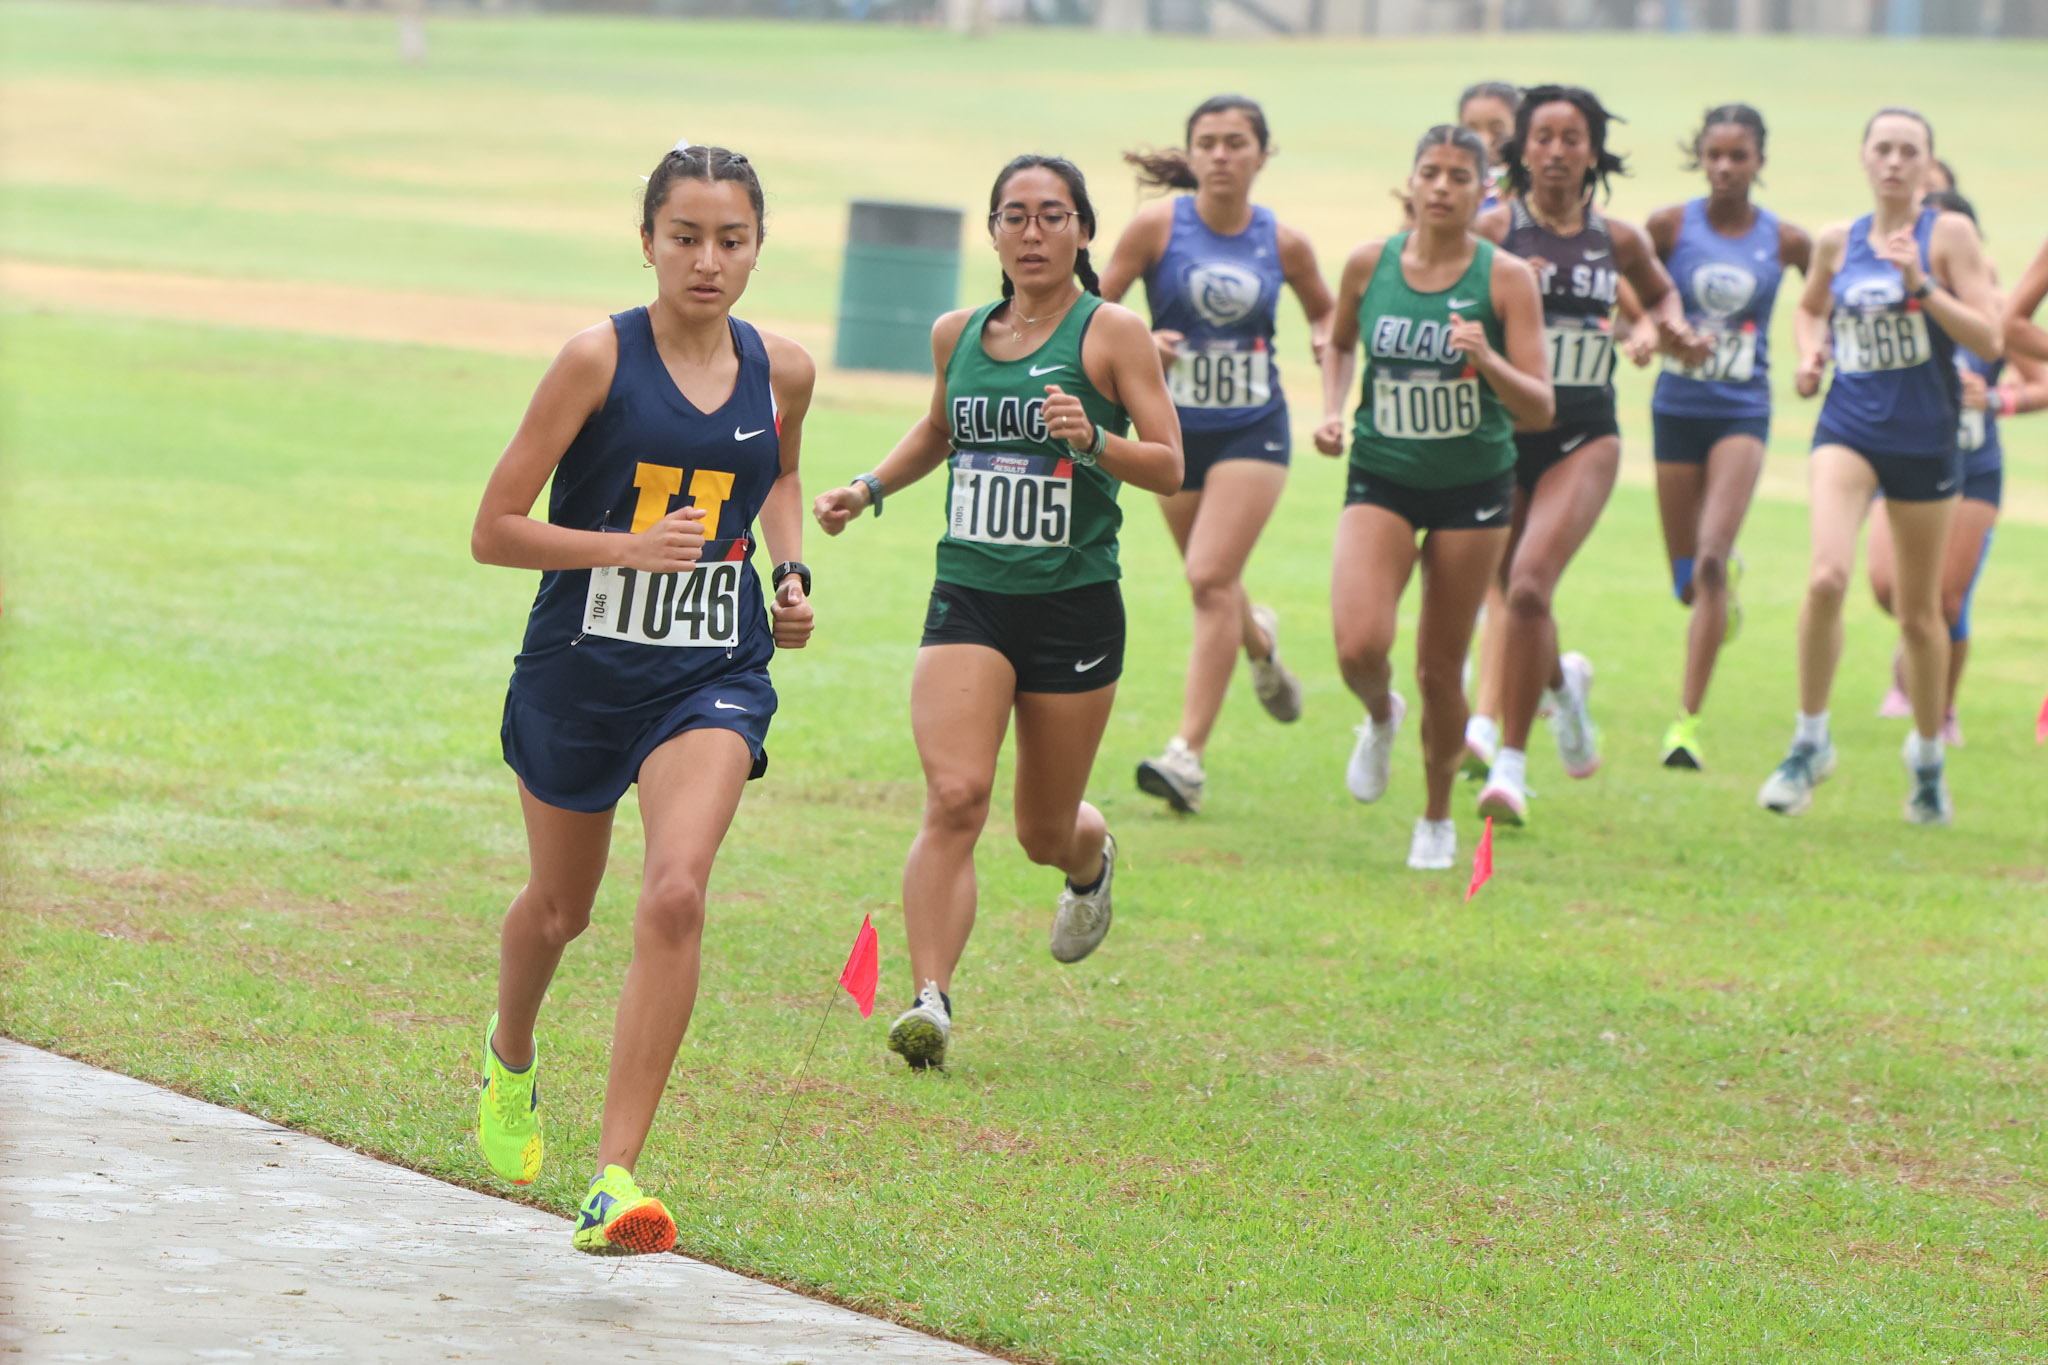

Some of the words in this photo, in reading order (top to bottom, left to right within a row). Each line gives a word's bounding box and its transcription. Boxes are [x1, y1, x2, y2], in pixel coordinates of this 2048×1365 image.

[1539, 261, 1565, 296] T.
[1372, 315, 1463, 364] ELAC
[1684, 334, 1740, 381] 62
[1854, 316, 1916, 366] 966
[1194, 355, 1253, 404] 961
[954, 397, 1050, 443] ELAC
[1391, 383, 1475, 433] 1006
[994, 465, 1026, 474] RESULTS
[954, 506, 964, 527] 1005
[969, 474, 1067, 542] 1005
[592, 593, 607, 619] 1046
[616, 565, 736, 641] 1046
